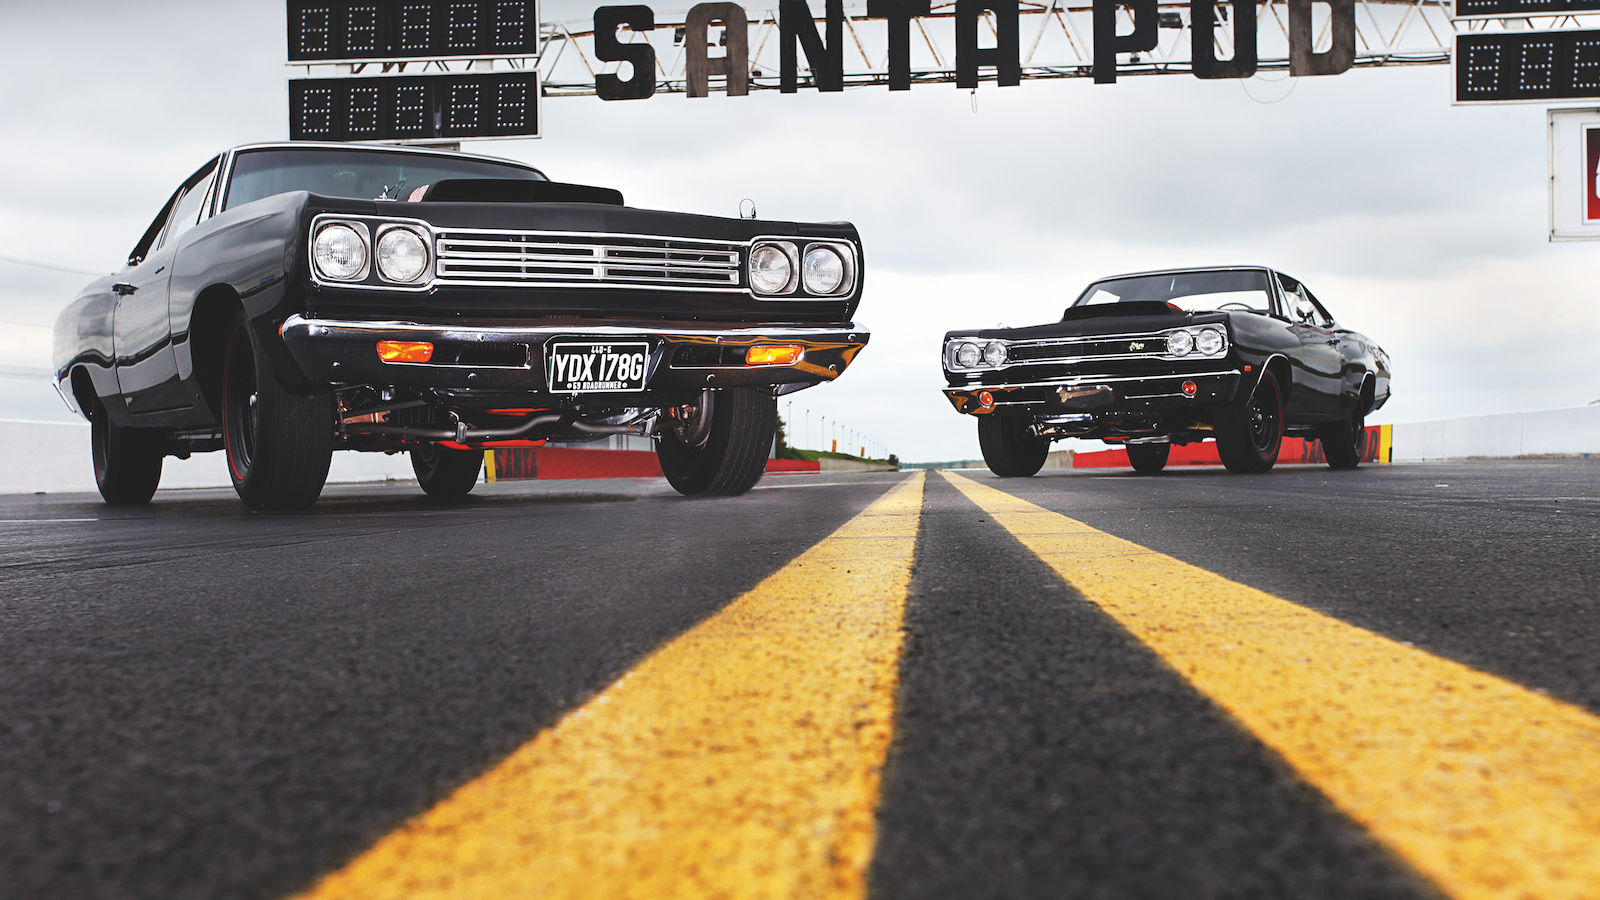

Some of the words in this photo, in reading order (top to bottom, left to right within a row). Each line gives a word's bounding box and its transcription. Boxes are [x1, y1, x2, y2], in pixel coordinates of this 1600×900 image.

[594, 0, 1020, 101] SANTA
[1093, 0, 1356, 85] POD
[555, 353, 596, 382] YDX
[599, 353, 643, 381] 178G
[495, 448, 537, 480] SANTA
